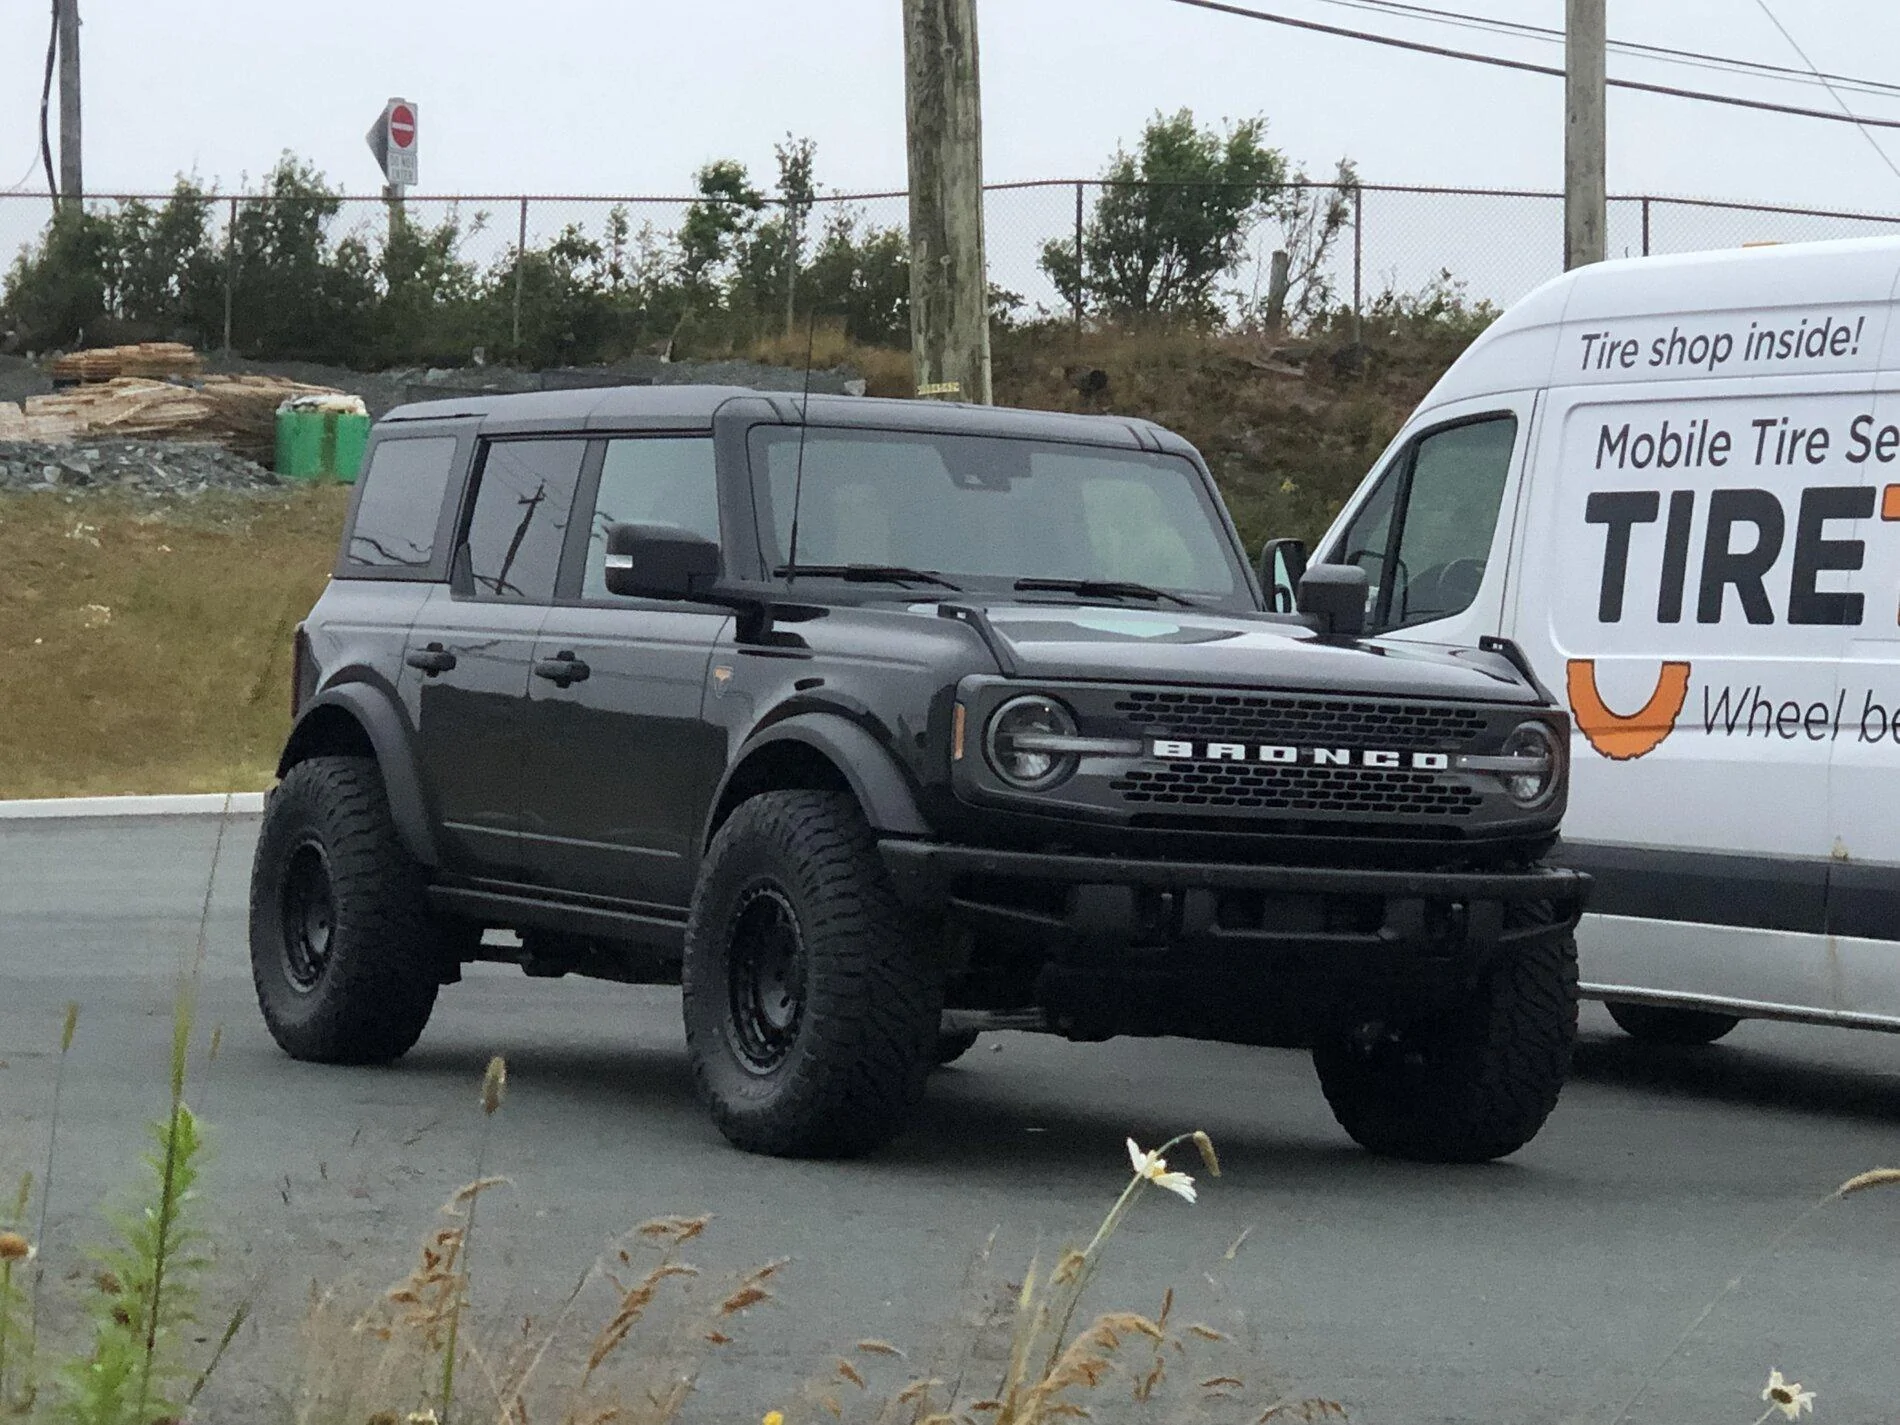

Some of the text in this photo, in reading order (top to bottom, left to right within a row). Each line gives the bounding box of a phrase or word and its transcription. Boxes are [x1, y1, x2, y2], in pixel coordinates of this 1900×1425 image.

[1581, 316, 1865, 371] Tire shop inside!
[1595, 418, 1731, 469] Mobile
[1751, 416, 1830, 465] Tire
[1703, 685, 1846, 741] Wheel
[1152, 739, 1448, 769] BRONCO
